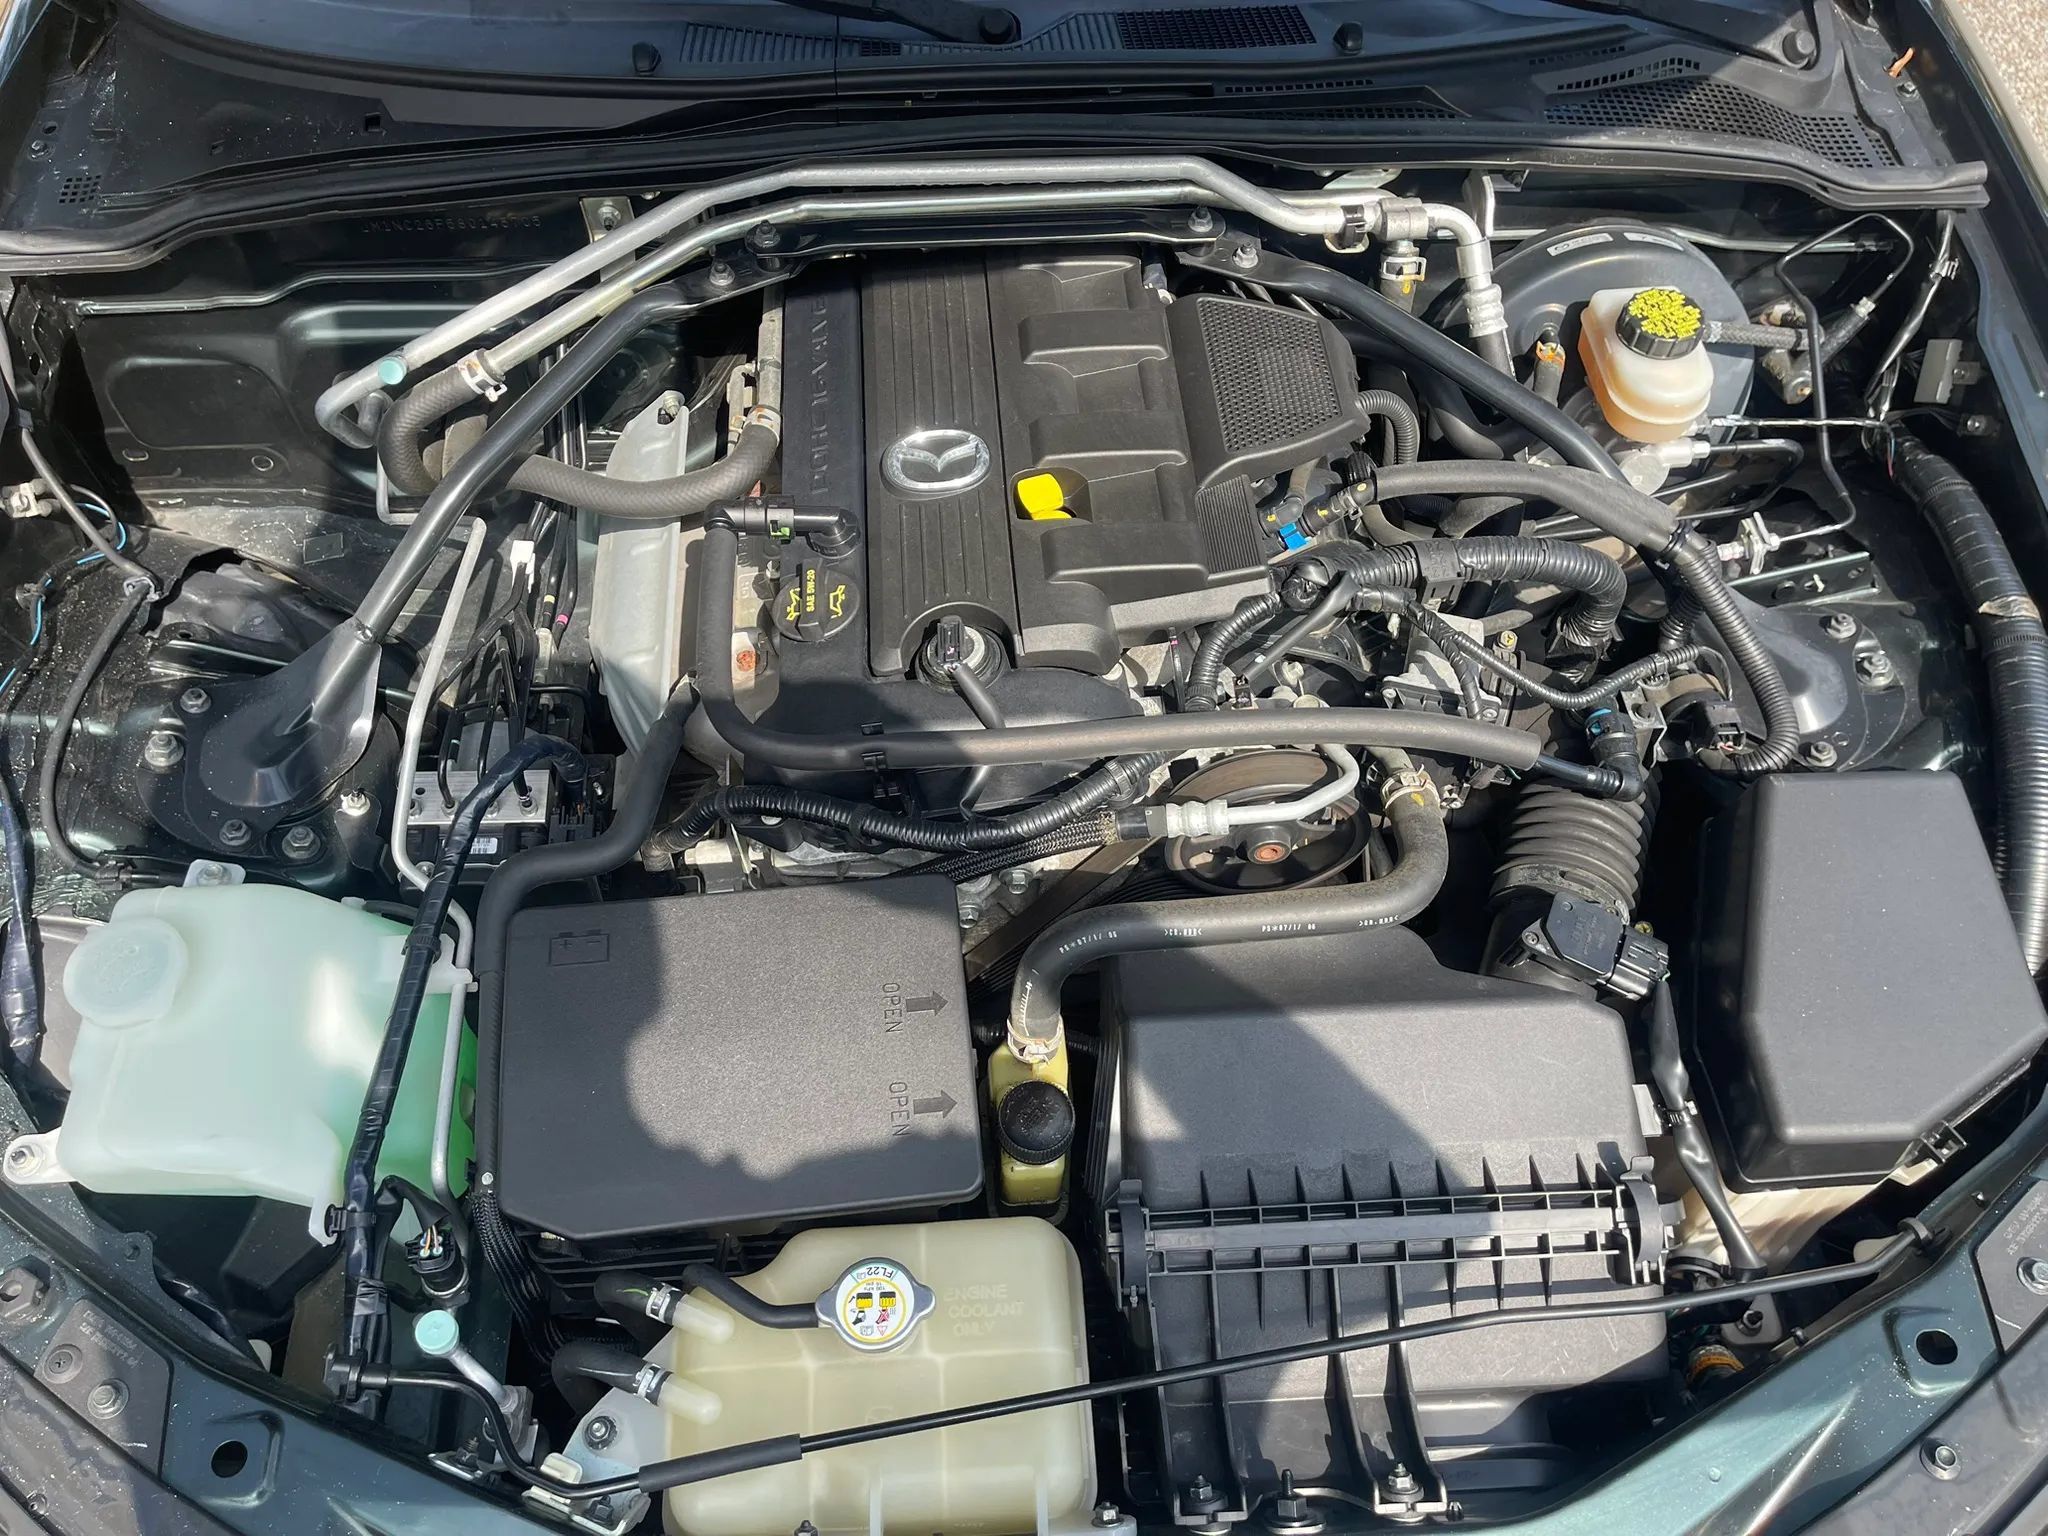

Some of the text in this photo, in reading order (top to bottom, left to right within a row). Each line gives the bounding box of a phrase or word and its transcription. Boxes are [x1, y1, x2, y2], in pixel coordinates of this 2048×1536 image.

[806, 569, 816, 612] SAE 5W-20
[882, 982, 903, 1033] OPEN
[889, 1081, 912, 1137] OPEN
[866, 1266, 894, 1279] FL22
[943, 1283, 1008, 1301] ENGINE
[948, 1300, 1024, 1319] COOLANT
